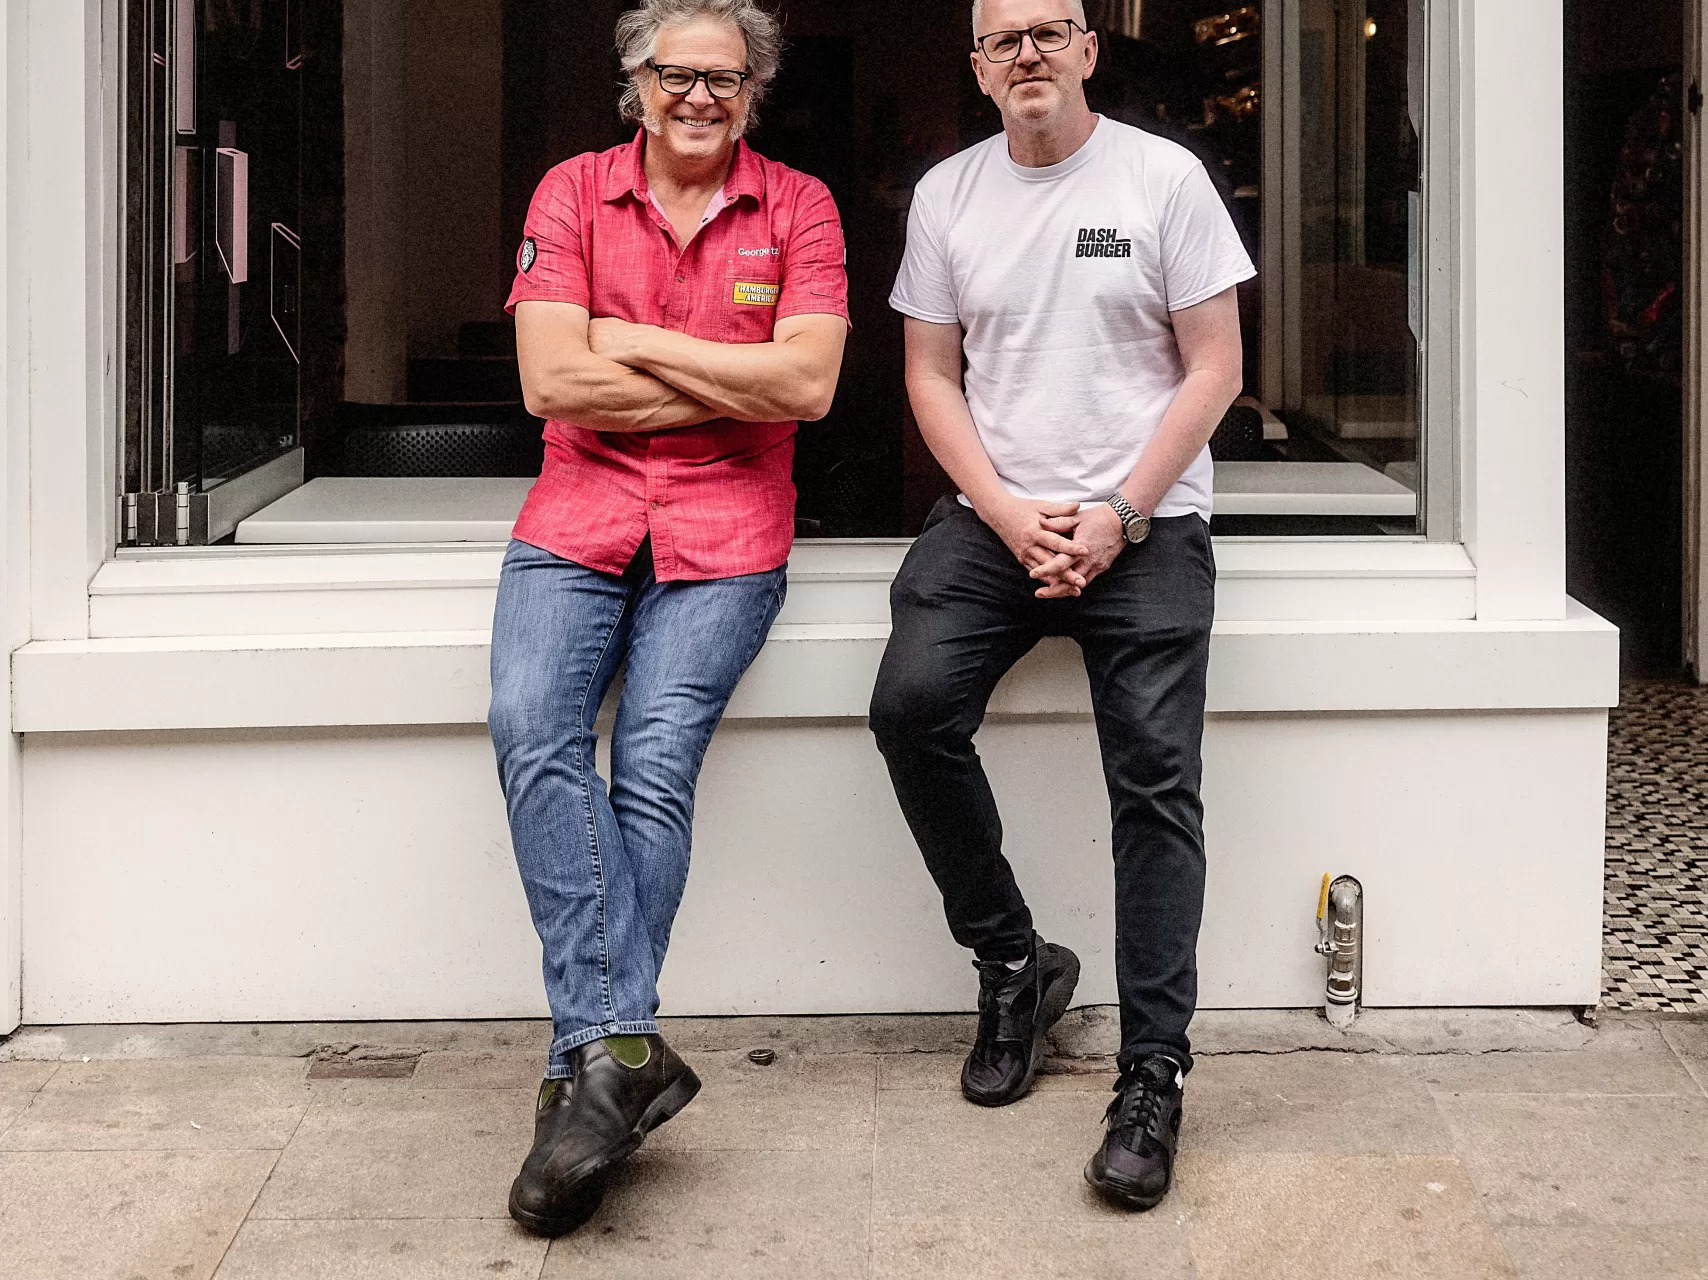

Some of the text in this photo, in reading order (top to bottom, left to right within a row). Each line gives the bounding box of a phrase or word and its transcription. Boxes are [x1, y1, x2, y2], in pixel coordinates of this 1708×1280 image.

[738, 247, 769, 257] George
[1075, 243, 1131, 258] BURGER
[744, 294, 775, 303] AMERICA
